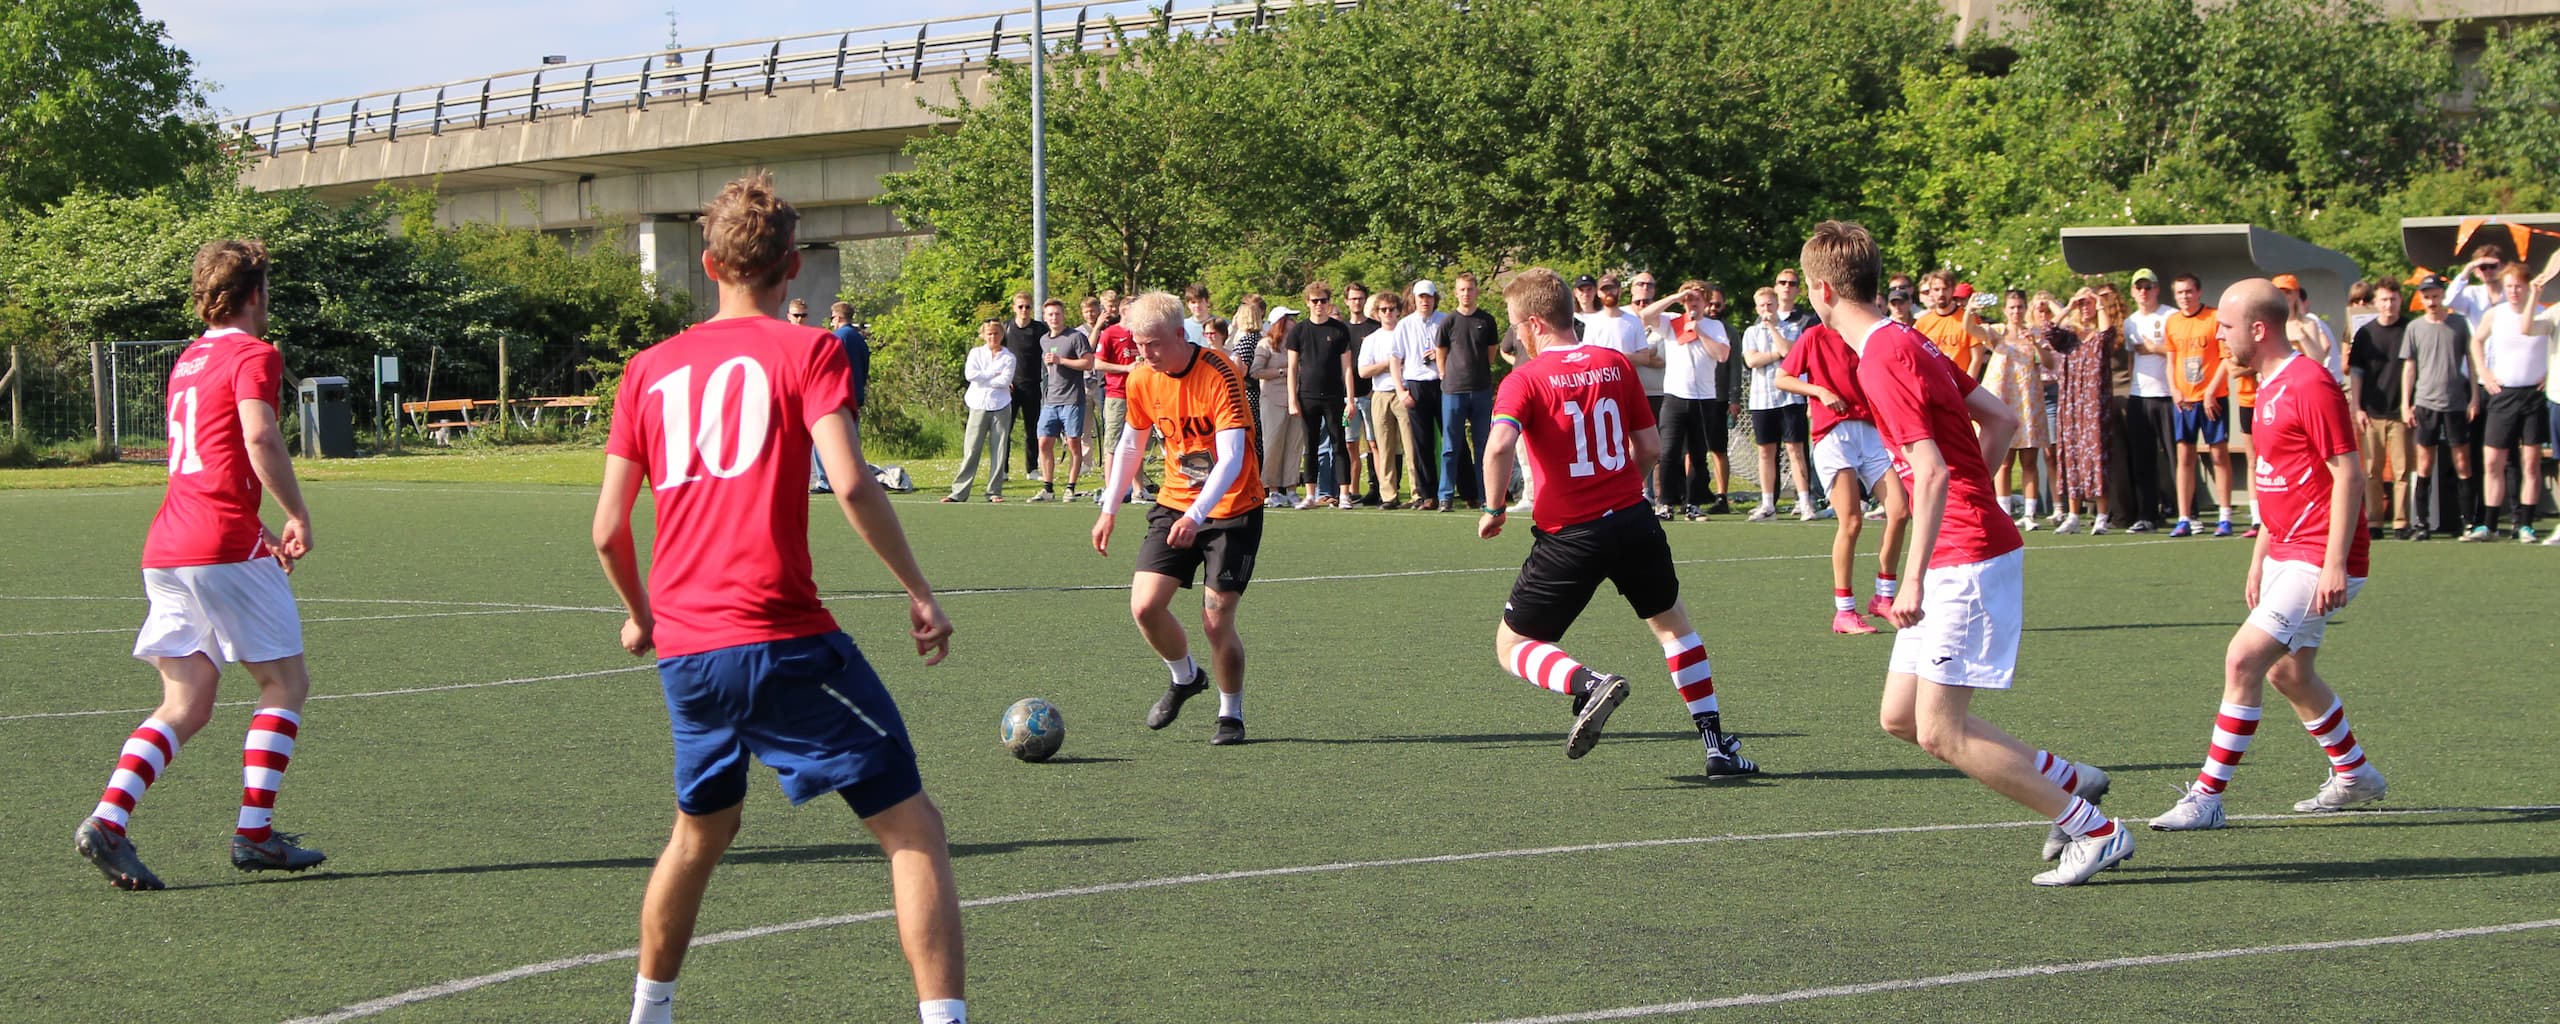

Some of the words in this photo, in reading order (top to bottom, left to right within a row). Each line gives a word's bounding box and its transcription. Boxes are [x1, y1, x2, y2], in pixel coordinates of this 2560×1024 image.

[1548, 366, 1622, 388] MALINOWSKI
[647, 355, 770, 491] 10
[1563, 397, 1626, 477] 10
